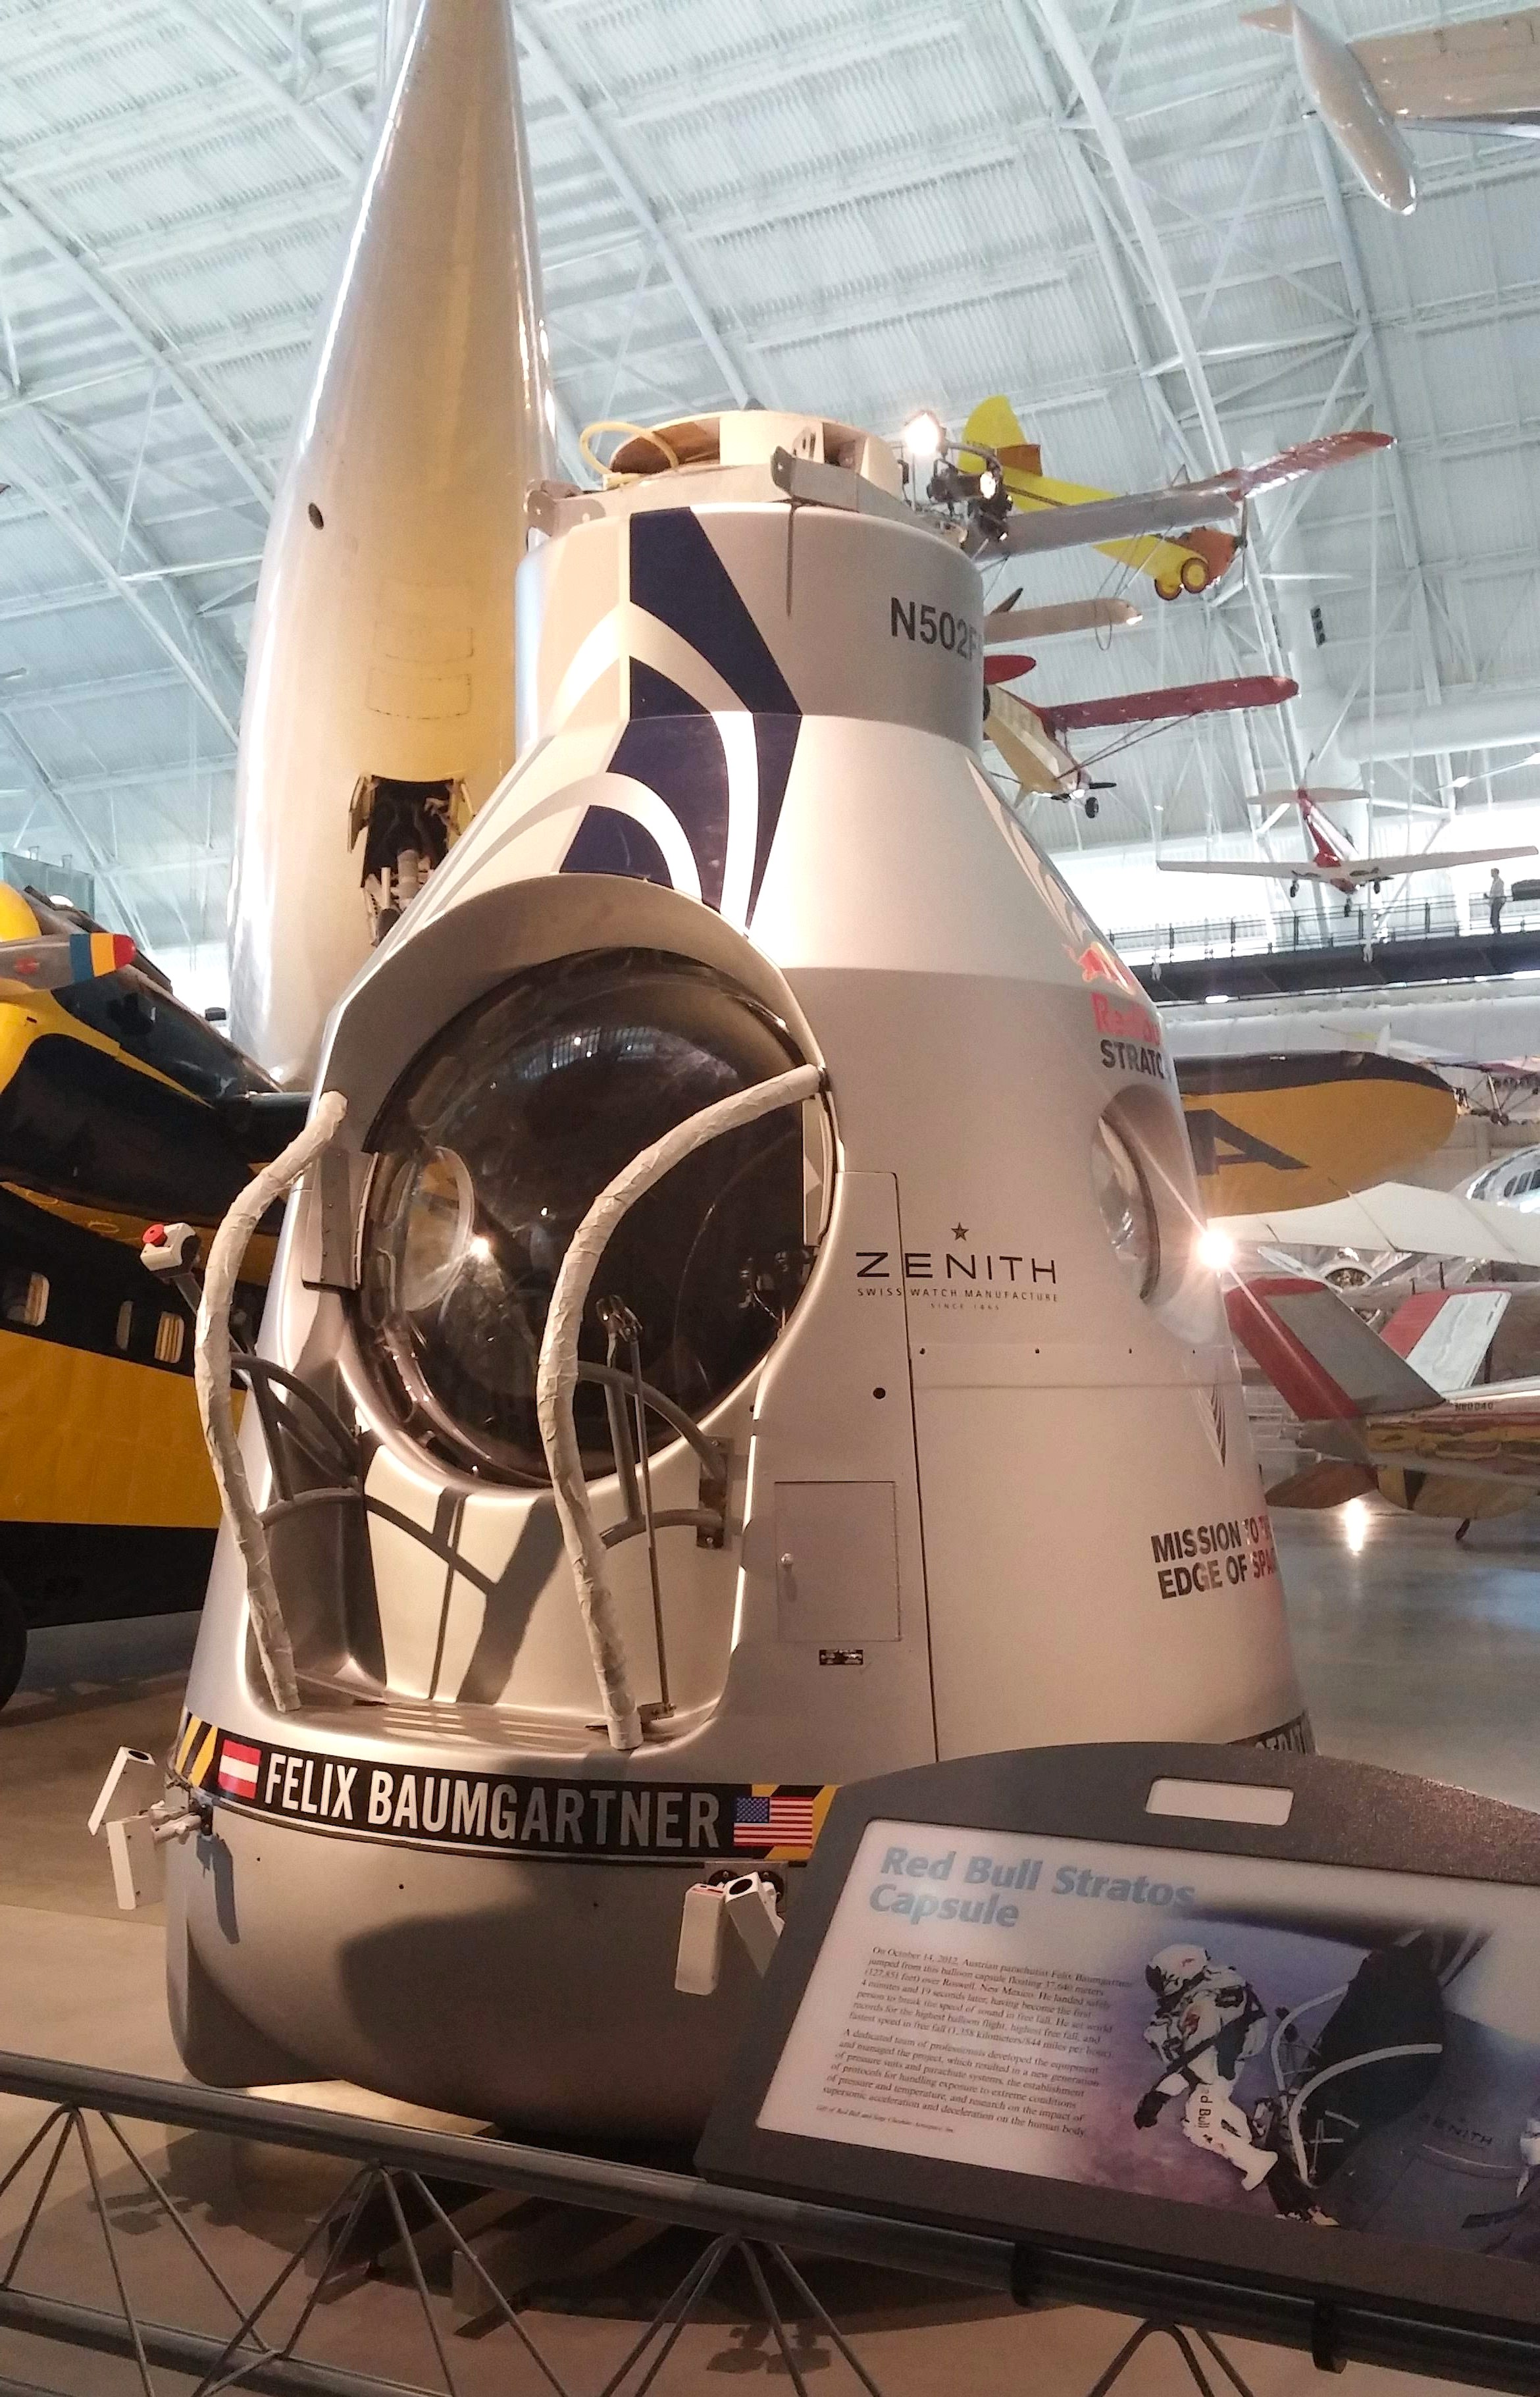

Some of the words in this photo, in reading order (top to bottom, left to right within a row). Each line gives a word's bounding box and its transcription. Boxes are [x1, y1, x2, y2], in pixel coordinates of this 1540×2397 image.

[856, 1252, 1056, 1283] ZENITH
[857, 1287, 903, 1297] SWISS
[911, 1288, 957, 1297] WATCH
[965, 1289, 1059, 1302] MANUFACTURE
[1151, 1520, 1242, 1563] MISSION
[1157, 1560, 1223, 1599] EDGE
[1226, 1554, 1248, 1584] OF
[264, 1753, 357, 1820] FELIX
[367, 1770, 719, 1849] BAUMGARTNER
[881, 1847, 956, 1880] Red
[963, 1856, 1043, 1890] Bull
[1051, 1865, 1196, 1909] Stratos
[869, 1883, 1019, 1928] Capsule
[869, 1958, 900, 1968] jumped
[902, 1960, 921, 1971] from
[924, 1964, 938, 1973] this
[941, 1966, 973, 1978] balloon
[975, 1973, 1006, 1982] capsule
[1008, 1975, 1042, 1989] floating
[1075, 1987, 1104, 1996] meters
[873, 1946, 885, 1955] On
[888, 1948, 920, 1959] October
[924, 1953, 935, 1963] 14,
[963, 1958, 998, 1970] Austrian
[1000, 1965, 1048, 1977] parachutist
[1052, 1971, 1071, 1980] Felix
[1075, 1974, 1133, 1988] Baumgartner
[857, 1991, 884, 1999] person
[899, 1995, 920, 2005] break
[924, 1999, 937, 2007] the
[939, 2003, 963, 2011] speed
[978, 2009, 1004, 2017] sound
[1018, 2011, 1034, 2021] free
[1056, 2018, 1068, 2026] He
[1087, 2024, 1112, 2033] world
[868, 1980, 900, 1991] minutes
[933, 1990, 965, 2000] seconds
[967, 1993, 988, 2005] later,
[991, 1997, 1019, 2010] having
[1022, 2001, 1054, 2013] become
[1057, 2007, 1071, 2015] the
[1073, 2008, 1091, 2019] first
[901, 1972, 920, 1983] feet)
[980, 1983, 998, 1993] New
[1039, 1992, 1051, 2000] He
[1054, 1994, 1083, 2005] landed
[1087, 1999, 1111, 2011] safely
[850, 2010, 875, 2022] fastest
[878, 2017, 901, 2026] speed
[913, 2020, 929, 2030] free
[932, 2023, 946, 2033] fall
[977, 2030, 1040, 2047] kilometers/844
[1042, 2042, 1065, 2051] miles
[853, 2002, 883, 2011] records
[886, 2004, 899, 2014] for
[900, 2007, 913, 2016] the
[915, 2009, 946, 2021] highest
[948, 2014, 979, 2026] balloon
[982, 2019, 1007, 2031] flight,
[1011, 2023, 1041, 2035] highest
[1044, 2028, 1061, 2038] free
[853, 2030, 892, 2043] dedicated
[895, 2036, 915, 2046] team
[917, 2040, 928, 2048] of
[929, 2043, 985, 2057] professionals
[988, 2050, 1032, 2064] developed
[1035, 2057, 1048, 2067] the
[1050, 2062, 1099, 2074] equipment
[857, 2044, 895, 2055] managed
[898, 2049, 910, 2057] the
[912, 2053, 944, 2064] project,
[946, 2057, 972, 2067] which
[975, 2062, 1010, 2073] resulted
[1012, 2066, 1020, 2075] in
[1050, 2074, 1099, 2086] generation
[835, 2051, 846, 2059] of
[846, 2055, 882, 2065] pressure
[923, 2067, 967, 2078] parachute
[969, 2074, 1004, 2086] systems,
[1007, 2078, 1021, 2087] the
[1023, 2082, 1085, 2097] establishment
[842, 2066, 881, 2077] protocols
[883, 2070, 896, 2080] for
[898, 2073, 937, 2088] handling
[938, 2081, 978, 2092] exposure
[991, 2090, 1027, 2101] extreme
[1029, 2096, 1075, 2108] conditions
[823, 2087, 866, 2099] supersonic
[869, 2095, 919, 2108] acceleration
[940, 2105, 994, 2121] deceleration
[1011, 2117, 1025, 2126] the
[1027, 2119, 1060, 2132] human
[827, 2074, 837, 2082] of
[837, 2077, 874, 2088] pressure
[894, 2085, 947, 2101] temperature,
[969, 2099, 1006, 2109] research
[1023, 2106, 1037, 2115] the
[1039, 2109, 1071, 2121] impact
[1198, 2108, 1211, 2128] Bull
